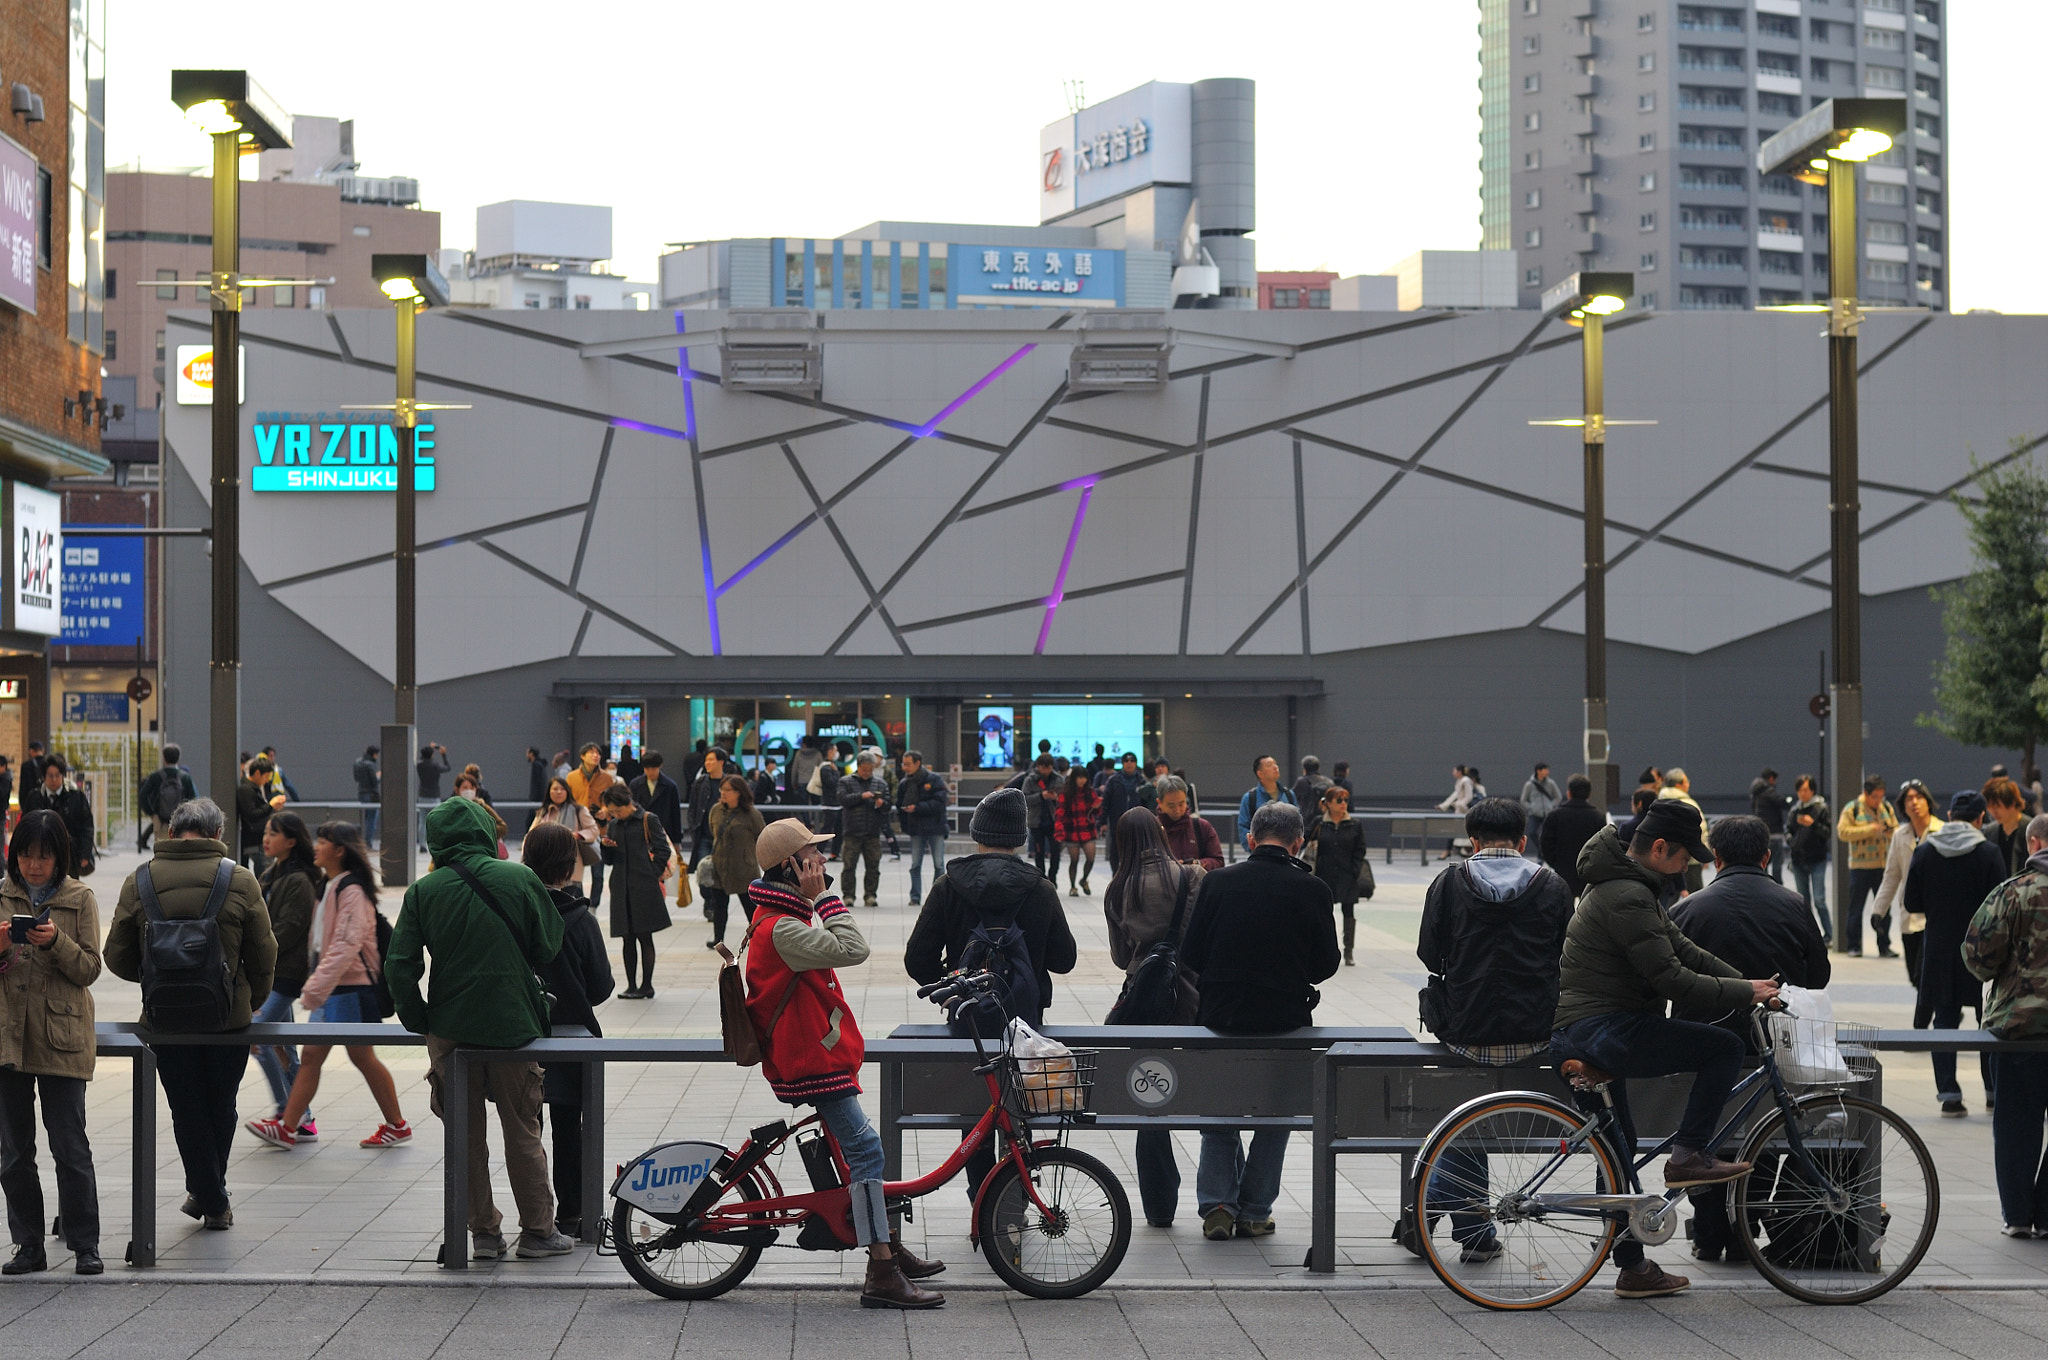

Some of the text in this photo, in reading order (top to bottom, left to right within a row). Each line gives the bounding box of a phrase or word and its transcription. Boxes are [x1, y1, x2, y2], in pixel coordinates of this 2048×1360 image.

[3, 163, 33, 221] WING
[12, 231, 33, 286] 新宿
[982, 250, 1092, 276] 東京外語
[253, 424, 435, 465] VR ZONE
[960, 1131, 980, 1154] docomo
[632, 1158, 711, 1192] Jump!
